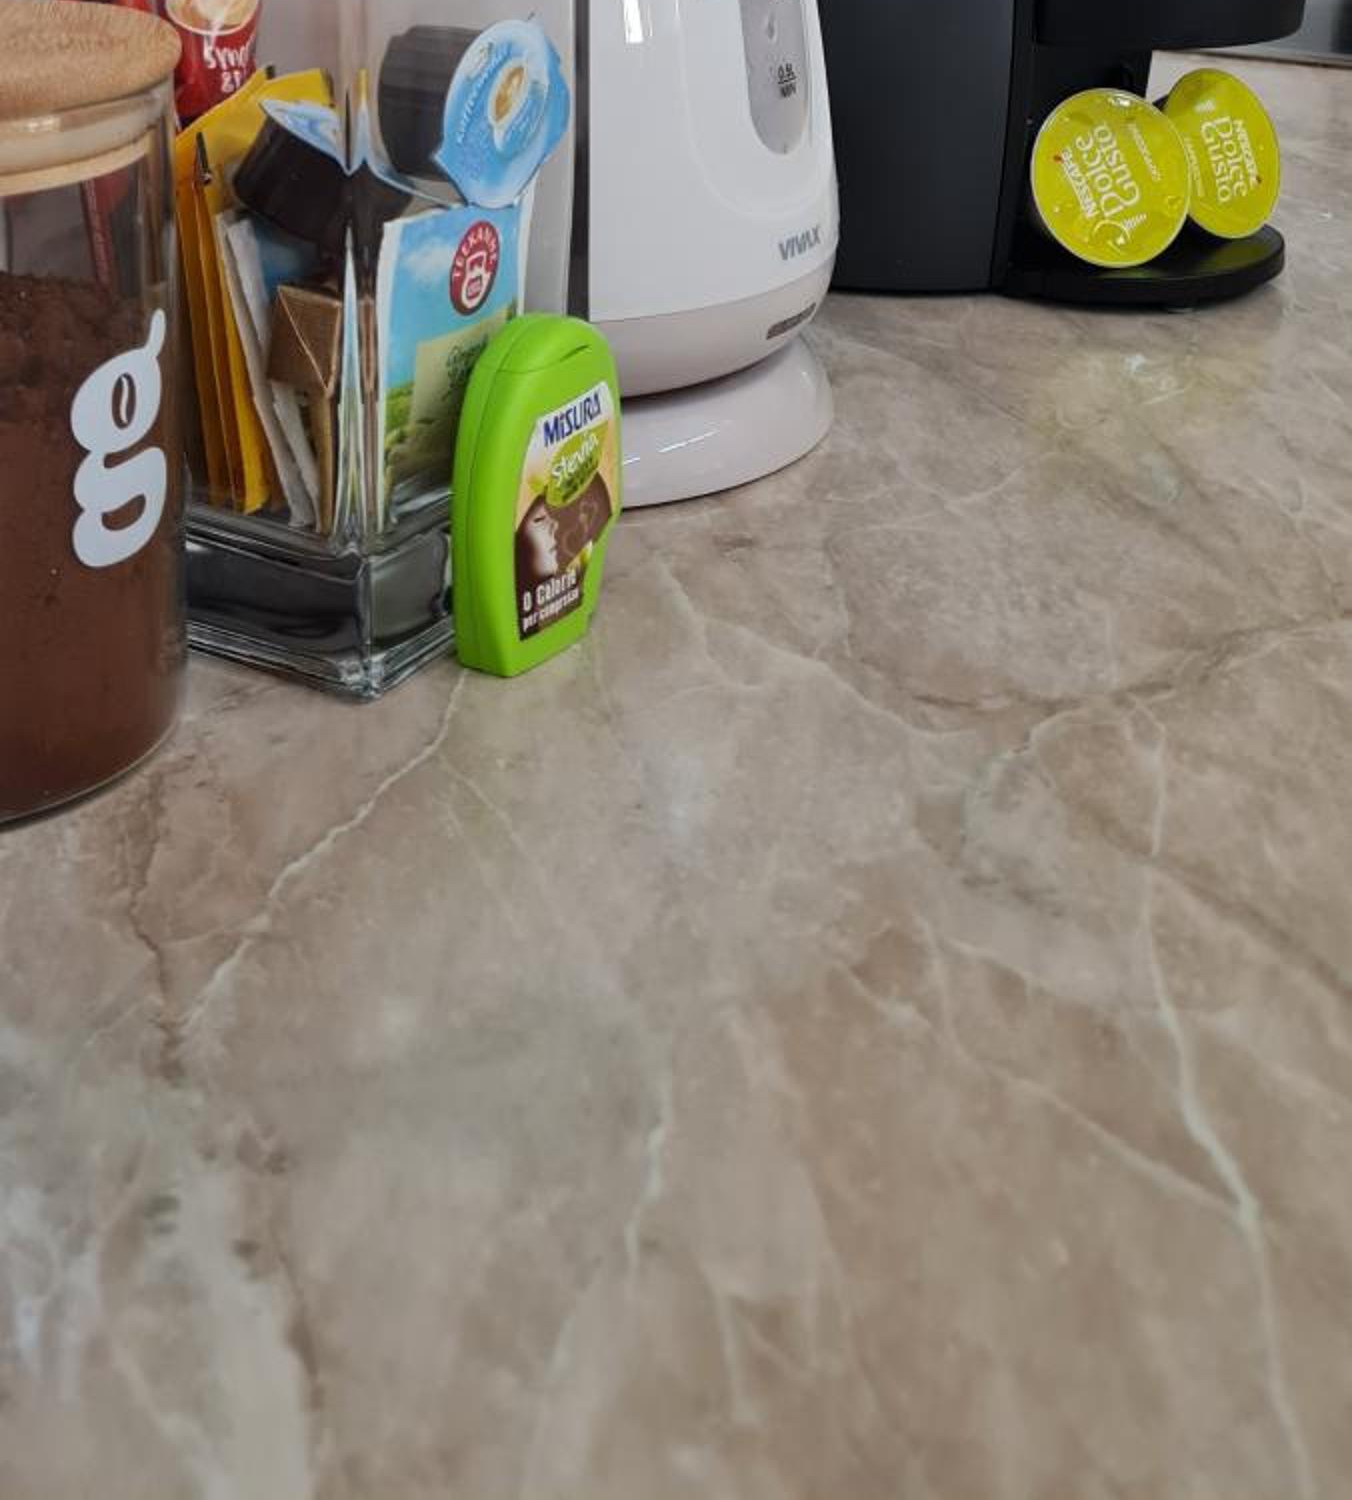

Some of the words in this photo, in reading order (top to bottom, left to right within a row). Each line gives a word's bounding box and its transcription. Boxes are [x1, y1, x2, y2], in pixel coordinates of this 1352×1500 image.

[1075, 132, 1125, 218] Dolce
[1093, 121, 1141, 207] Gusto
[1201, 120, 1233, 203] Gusto
[1214, 116, 1249, 198] Dolce
[778, 225, 821, 261] VIVAX
